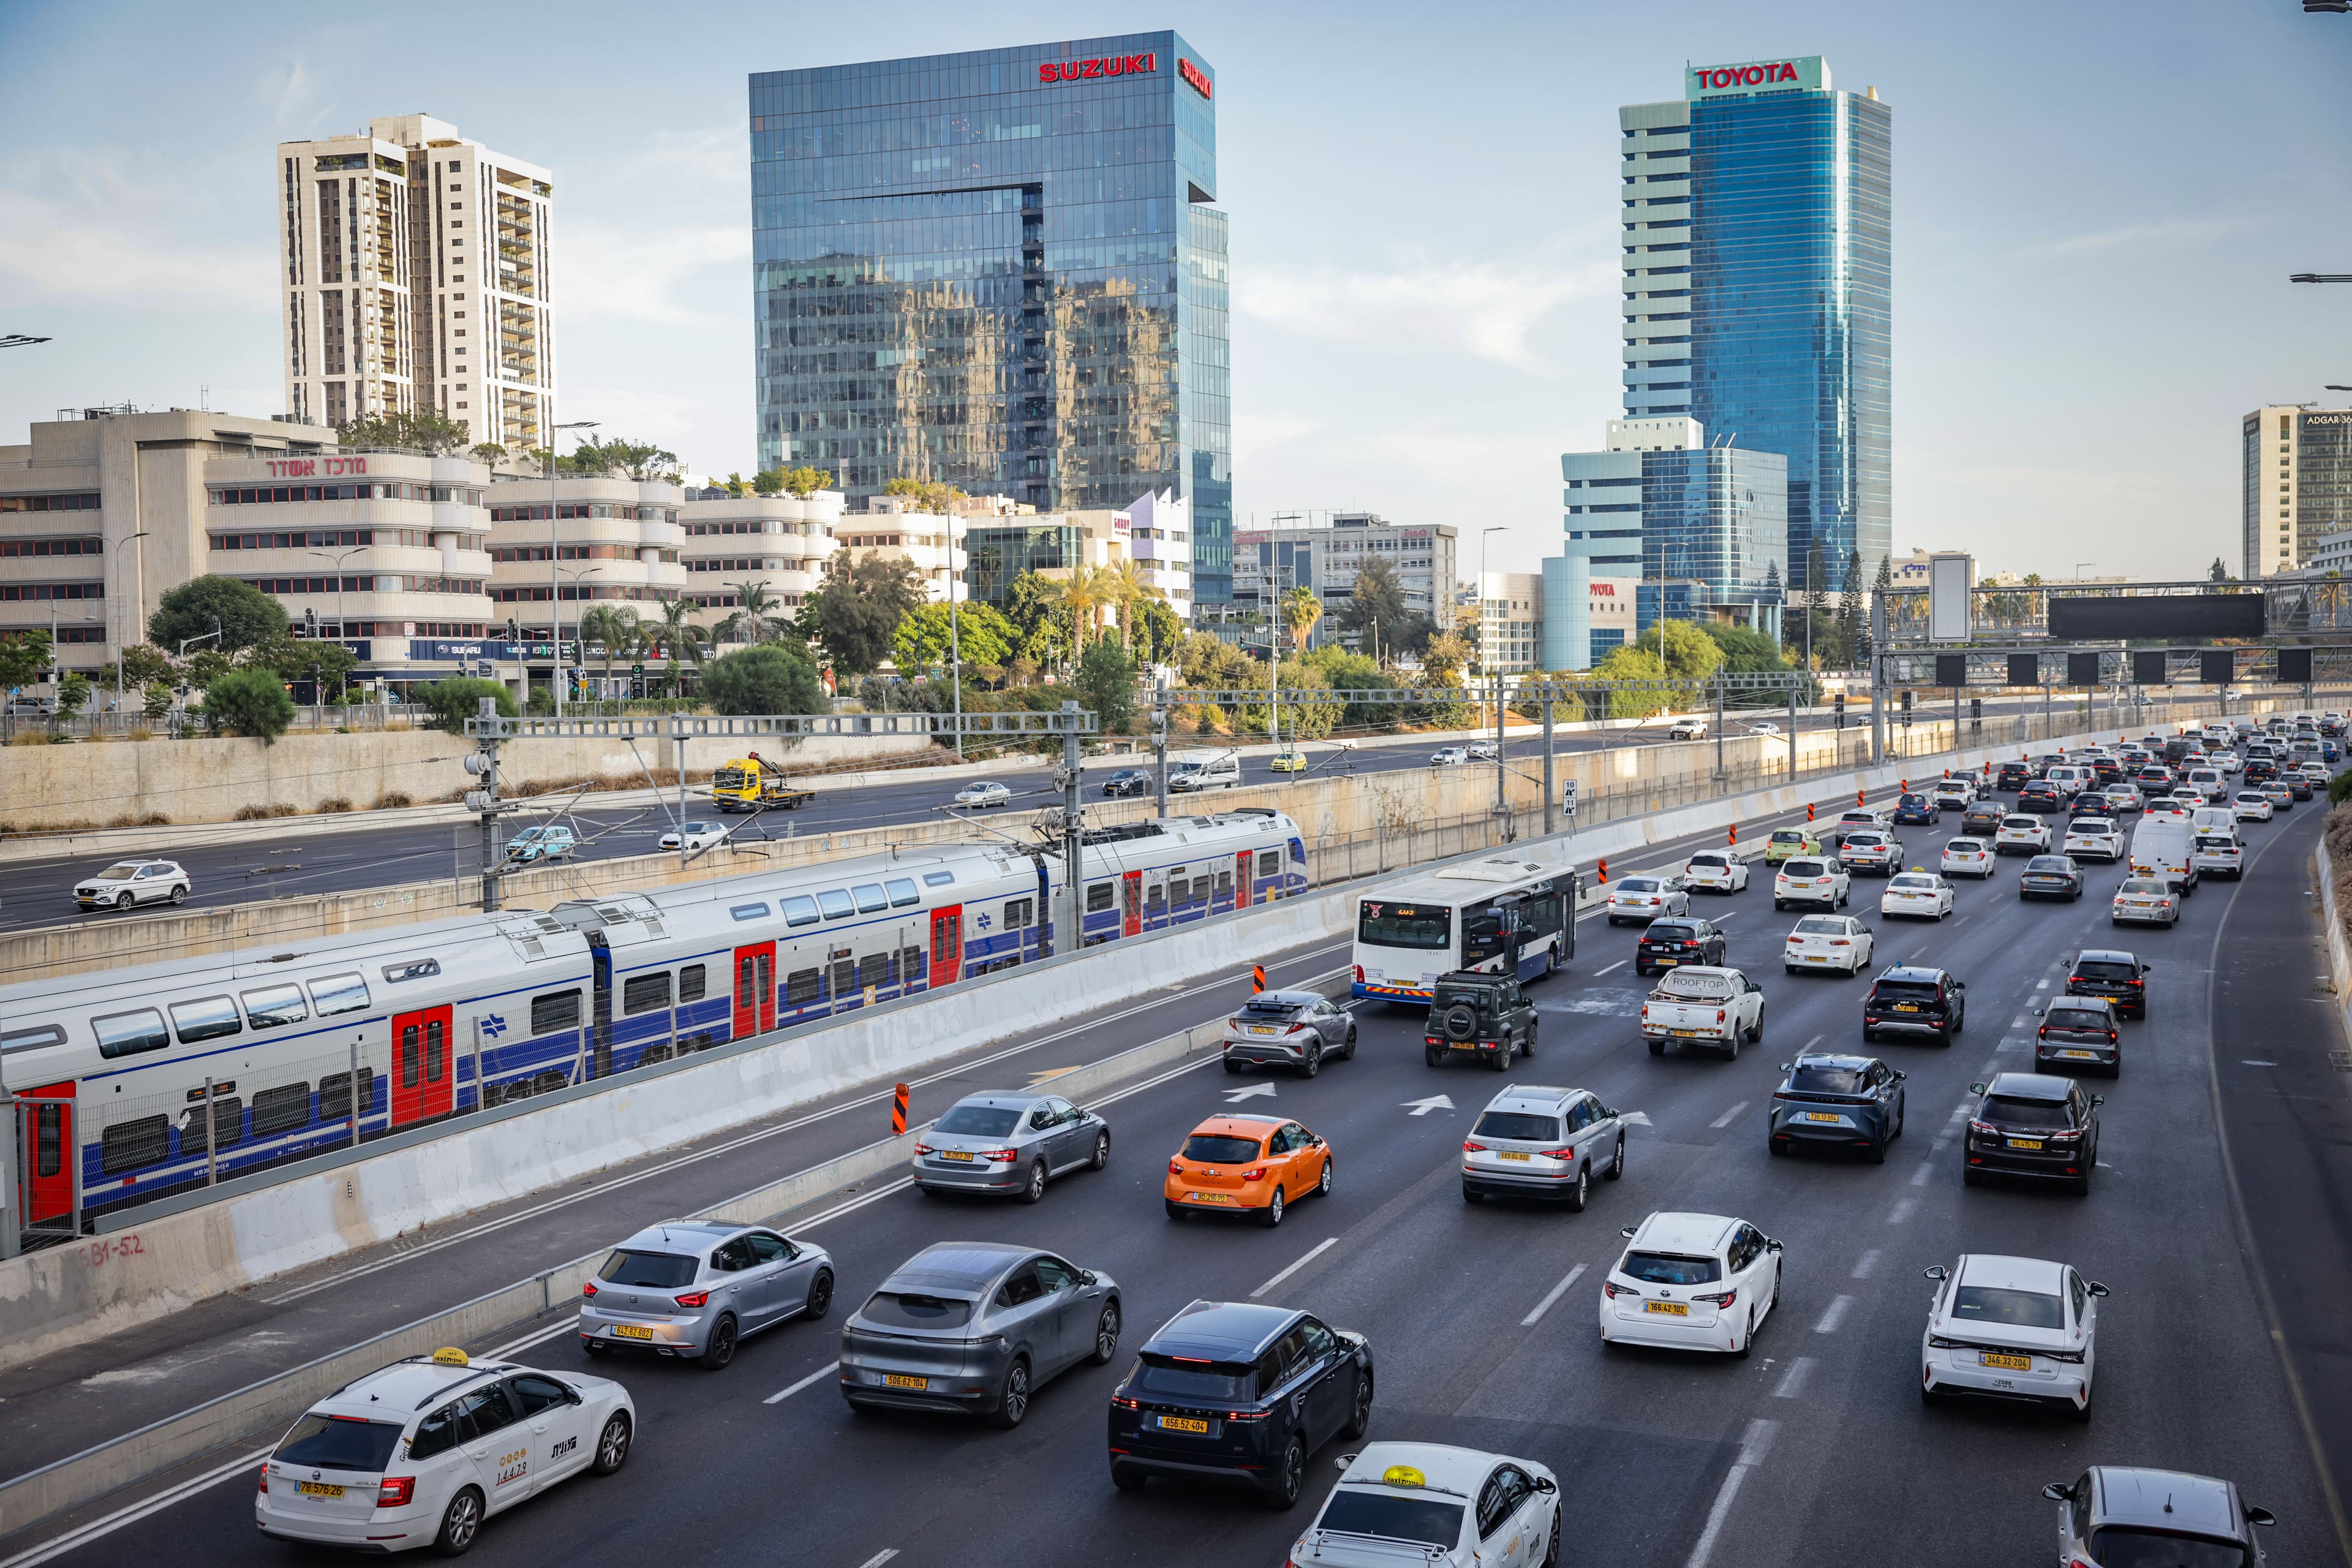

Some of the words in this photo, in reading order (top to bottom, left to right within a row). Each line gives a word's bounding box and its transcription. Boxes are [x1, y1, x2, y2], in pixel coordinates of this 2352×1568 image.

[1038, 53, 1156, 83] SUZUKI
[1697, 62, 1799, 89] TOYOTA
[1181, 58, 1212, 99] SUZUKI
[2307, 415, 2339, 424] ADGAR
[2342, 415, 2352, 424] 36
[265, 459, 316, 477] אשדר
[324, 457, 367, 475] מרכז
[1673, 978, 1723, 989] ROOFTOP
